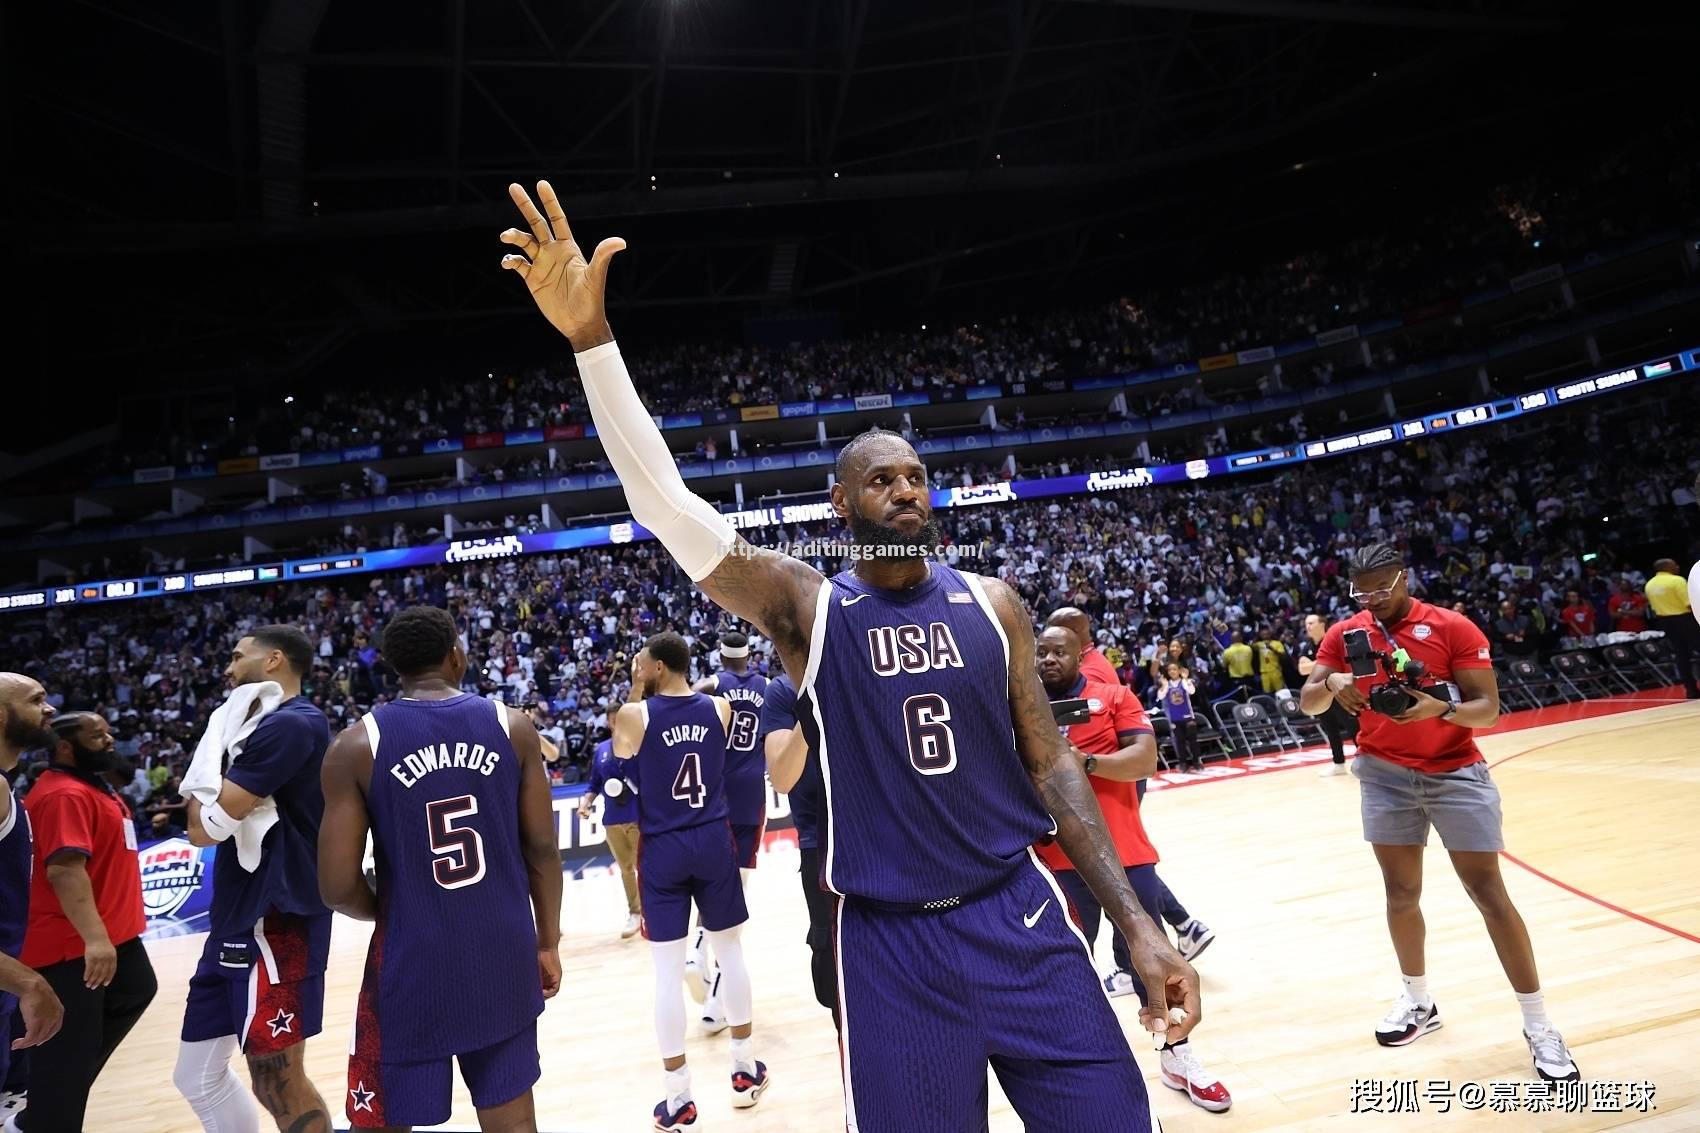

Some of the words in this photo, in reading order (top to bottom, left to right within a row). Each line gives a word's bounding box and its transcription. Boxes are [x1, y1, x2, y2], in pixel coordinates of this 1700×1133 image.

[868, 622, 965, 677] USA
[723, 688, 765, 708] ADEBAYO
[662, 724, 709, 747] CURRY
[903, 693, 957, 776] 6
[390, 742, 500, 789] EDWARDS
[672, 752, 706, 809] 4
[425, 794, 487, 890] 5
